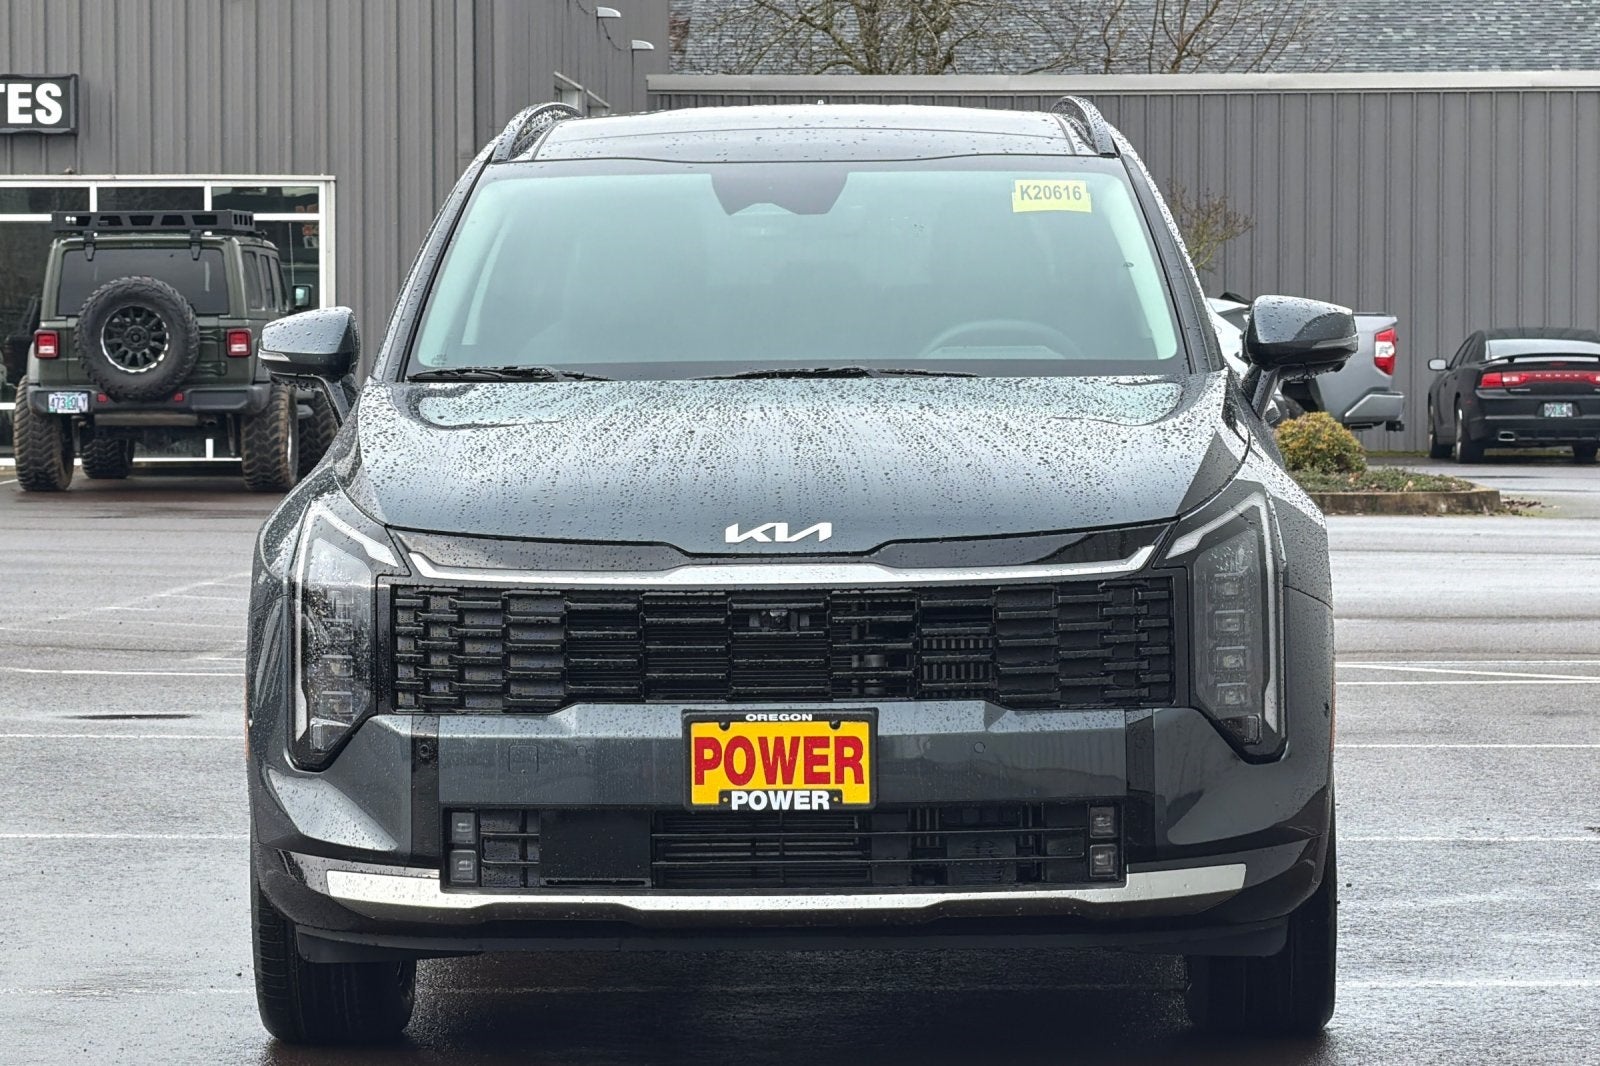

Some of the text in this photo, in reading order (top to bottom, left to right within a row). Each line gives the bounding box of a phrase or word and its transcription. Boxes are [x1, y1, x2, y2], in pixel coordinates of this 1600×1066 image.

[0, 83, 62, 125] ES
[1020, 184, 1082, 201] K20616
[725, 522, 832, 543] KIA
[745, 713, 813, 722] OREGON
[694, 735, 865, 786] POWER
[731, 790, 830, 811] POWER
